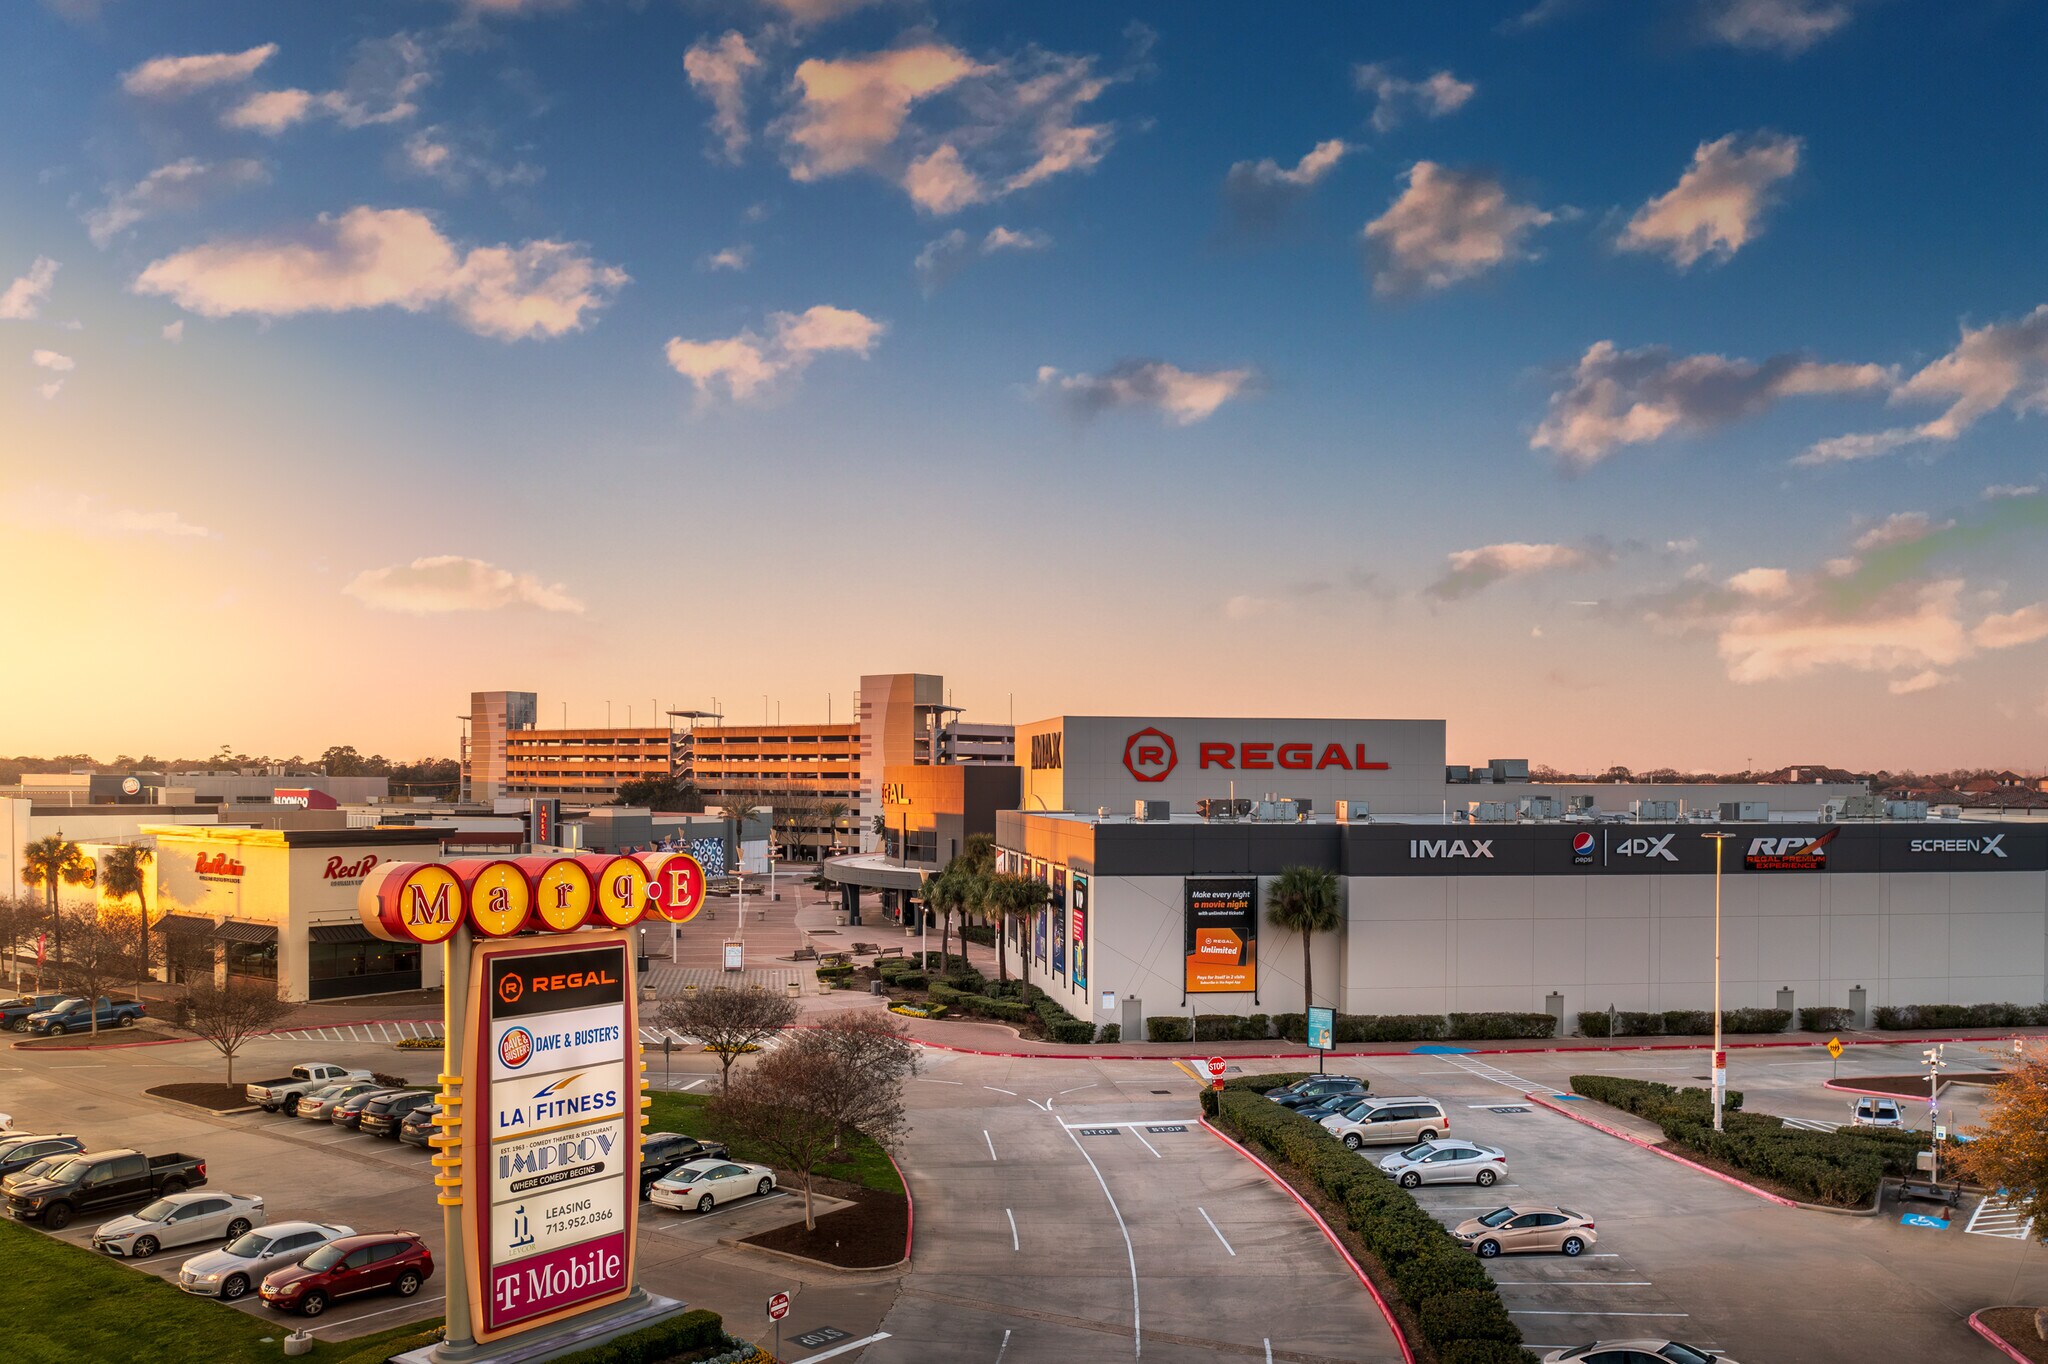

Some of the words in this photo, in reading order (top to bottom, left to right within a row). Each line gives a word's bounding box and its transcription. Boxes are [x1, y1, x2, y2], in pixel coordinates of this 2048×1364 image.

[1031, 732, 1062, 769] IMAX
[1200, 743, 1390, 770] REGAL
[882, 784, 911, 804] GAL
[1410, 840, 1494, 858] IMAX
[1616, 833, 1679, 861] 4DX
[1747, 832, 1834, 855] RPX
[323, 855, 363, 879] Red
[1192, 891, 1211, 899] Make
[1232, 891, 1251, 899] night
[1200, 900, 1226, 908] movie
[1226, 900, 1249, 910] night
[1200, 945, 1238, 955] Unlimited
[532, 970, 616, 993] REGAL
[504, 1035, 523, 1052] DAVE
[535, 1034, 561, 1052] DAVE
[564, 1033, 572, 1048] &
[574, 1025, 619, 1046] BUSTER'S
[1208, 1061, 1226, 1071] STOP
[500, 1108, 525, 1128] LA
[536, 1090, 617, 1120] FITNESS
[512, 1144, 525, 1152] 1963
[529, 1139, 552, 1148] COMEDY
[552, 1134, 575, 1143] THEATRE
[581, 1126, 613, 1137] RESTAURANT
[1151, 1125, 1183, 1133] STOP
[499, 1131, 618, 1180] IMPROV
[512, 1179, 539, 1191] WHERE
[539, 1172, 568, 1184] COMEDY
[569, 1164, 596, 1177] BEGINS
[545, 1198, 592, 1220] LEASING
[545, 1208, 614, 1236] 713.952.0366
[508, 1242, 537, 1257] LEVCOR
[526, 1248, 621, 1304] Mobile
[773, 1308, 786, 1317] ENTER
[799, 1328, 845, 1346] STOP
